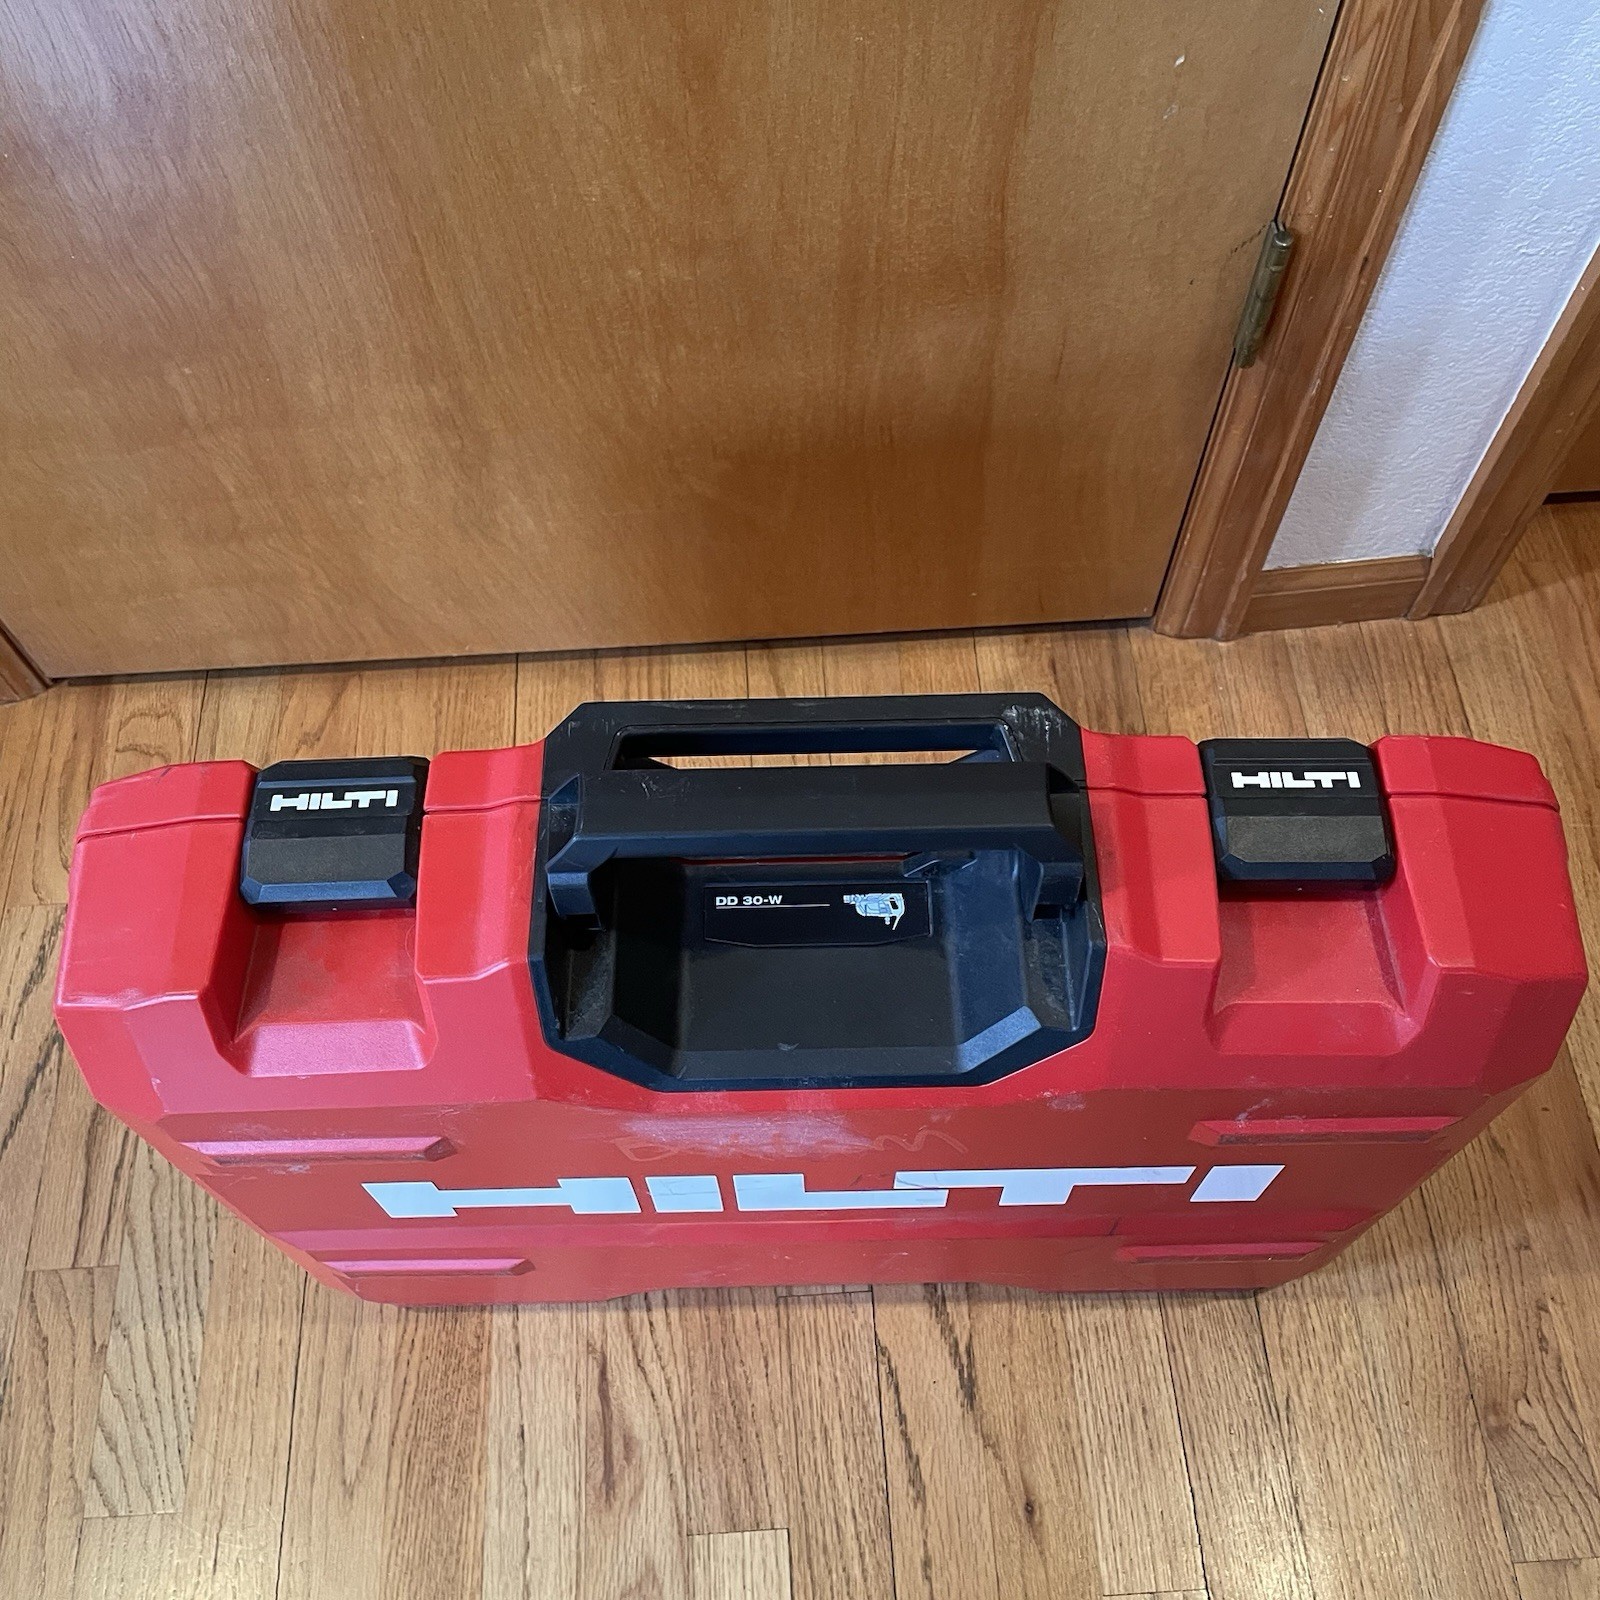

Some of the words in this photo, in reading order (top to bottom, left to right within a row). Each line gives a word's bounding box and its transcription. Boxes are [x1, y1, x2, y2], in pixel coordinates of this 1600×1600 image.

[1230, 771, 1362, 789] HILTI
[270, 789, 399, 812] HILTI
[715, 896, 739, 906] DD
[742, 894, 783, 906] 30-W
[361, 1165, 1286, 1219] HILTI
